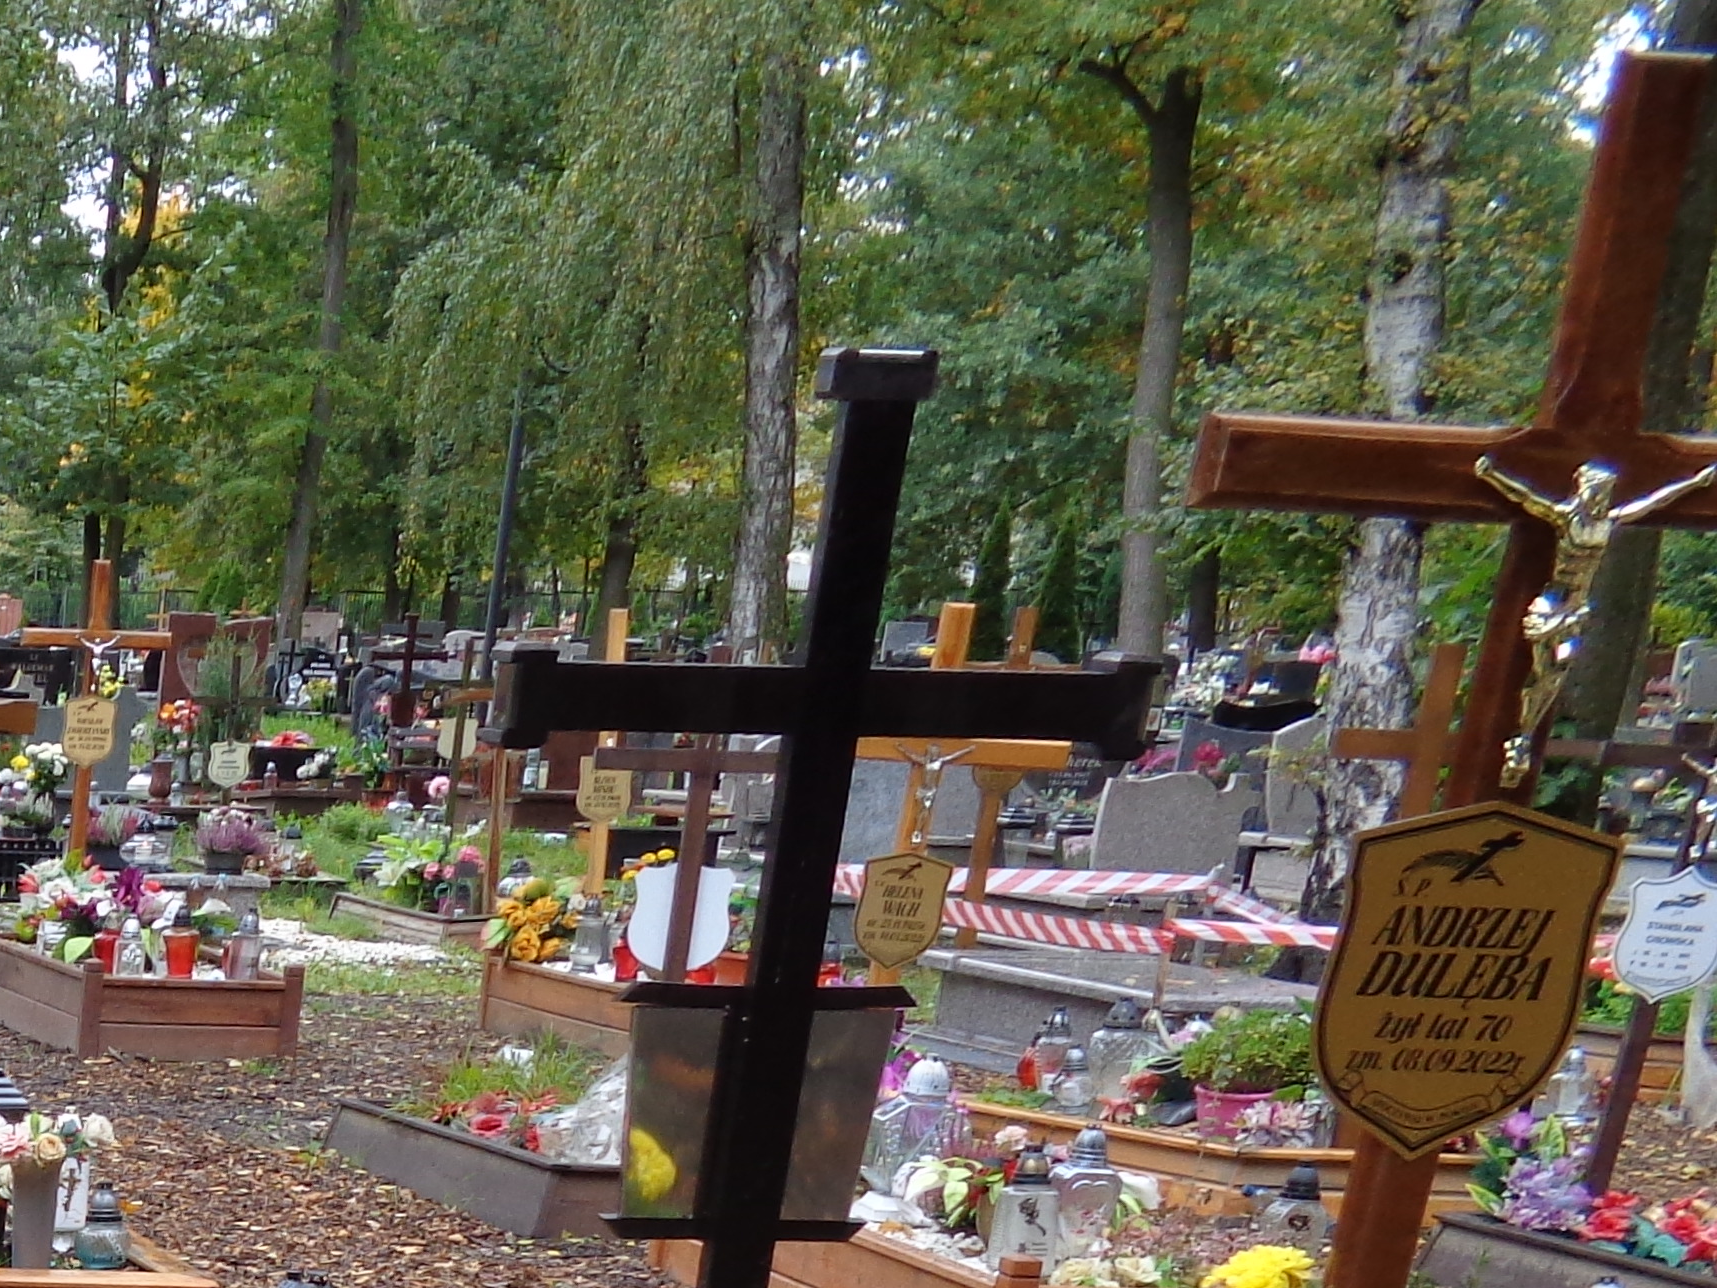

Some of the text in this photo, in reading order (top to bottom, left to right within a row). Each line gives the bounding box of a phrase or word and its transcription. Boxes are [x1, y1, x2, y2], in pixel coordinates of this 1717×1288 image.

[1370, 904, 1558, 957] ANDRZEJ
[1425, 1013, 1470, 1041] lat
[1474, 1014, 1514, 1042] 70
